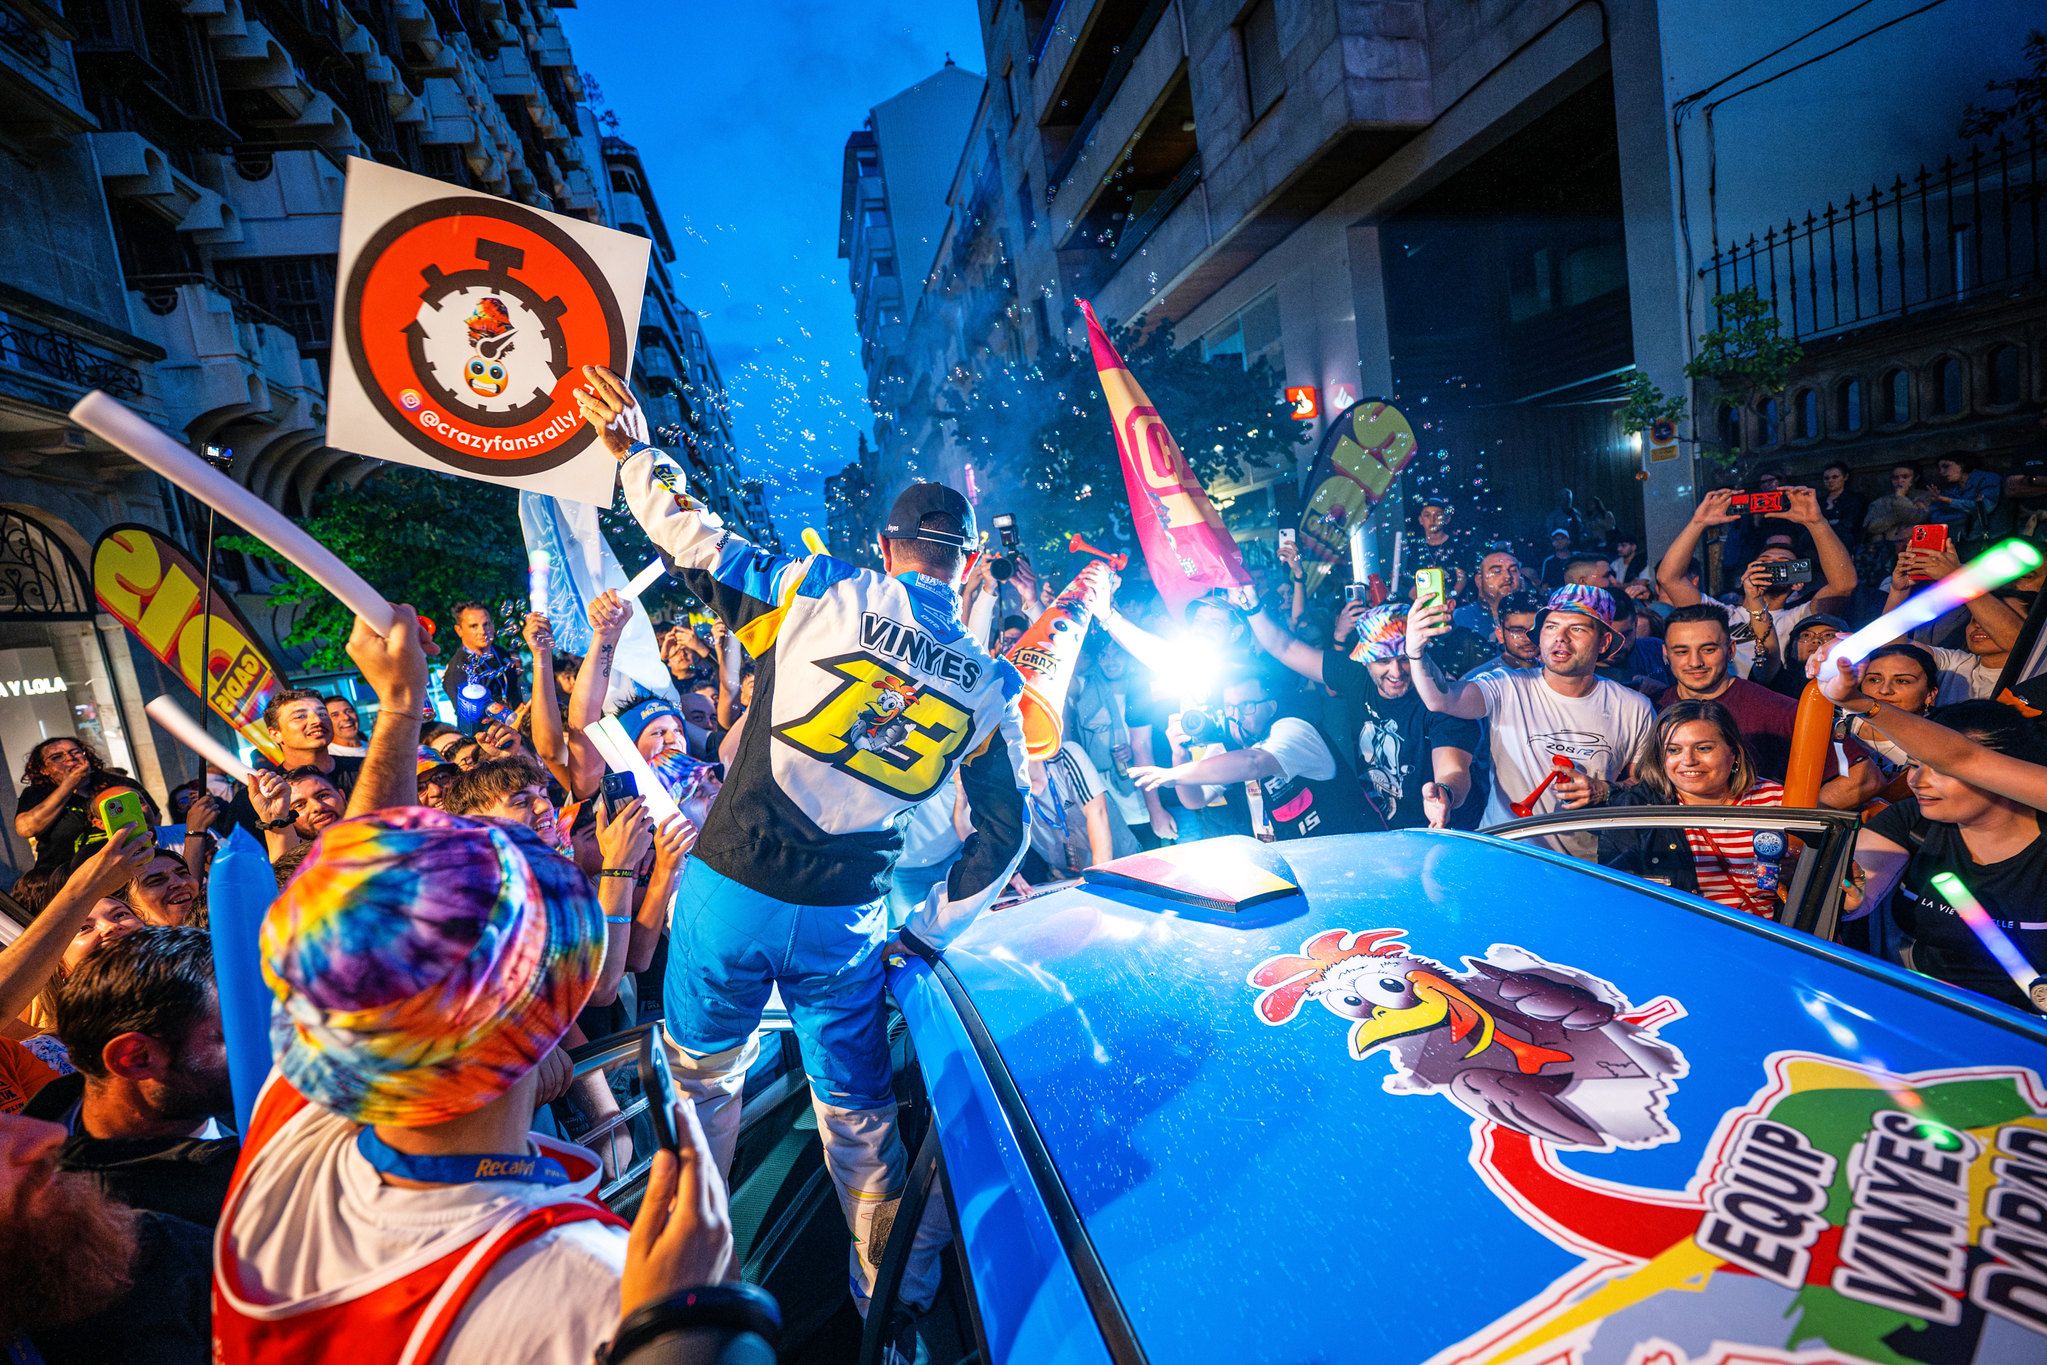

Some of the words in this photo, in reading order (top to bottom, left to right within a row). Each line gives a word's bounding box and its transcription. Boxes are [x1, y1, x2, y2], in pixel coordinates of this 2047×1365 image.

[861, 612, 981, 692] VINYES
[7, 680, 20, 697] Y
[22, 676, 67, 696] LOLA
[771, 651, 976, 802] 13
[1546, 742, 1575, 753] 208
[1921, 898, 1934, 908] LA
[1939, 904, 1955, 915] VIE
[1993, 919, 2014, 929] LLE
[1702, 1119, 1831, 1284] EQUIP
[1838, 1111, 1970, 1320] VINYES
